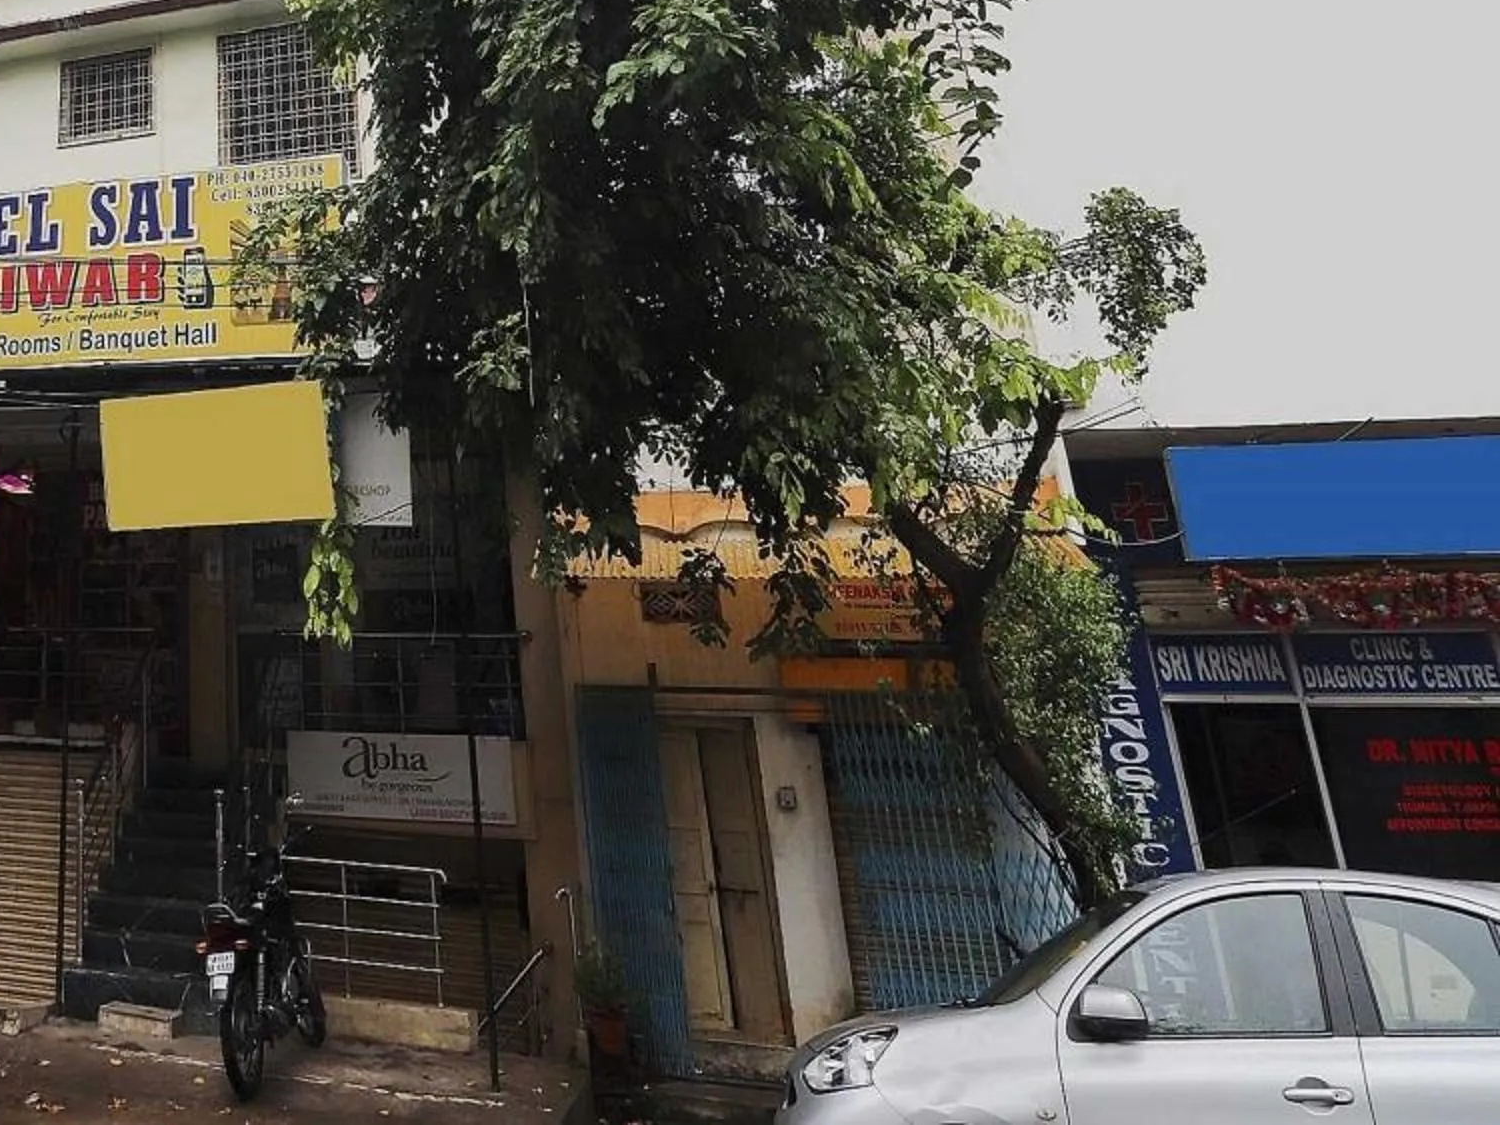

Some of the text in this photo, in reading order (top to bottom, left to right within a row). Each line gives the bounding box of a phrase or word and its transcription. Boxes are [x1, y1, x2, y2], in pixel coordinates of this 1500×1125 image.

[212, 186, 241, 201] Cell:
[88, 176, 196, 247] SAI
[79, 325, 168, 353] Banquet
[175, 322, 217, 346] Hall
[1157, 645, 1286, 682] SRI KRISHNA
[1350, 635, 1434, 661] CLINIC &
[1302, 664, 1499, 690] DIAGNOSTIC CENTRE
[341, 735, 428, 779] abha
